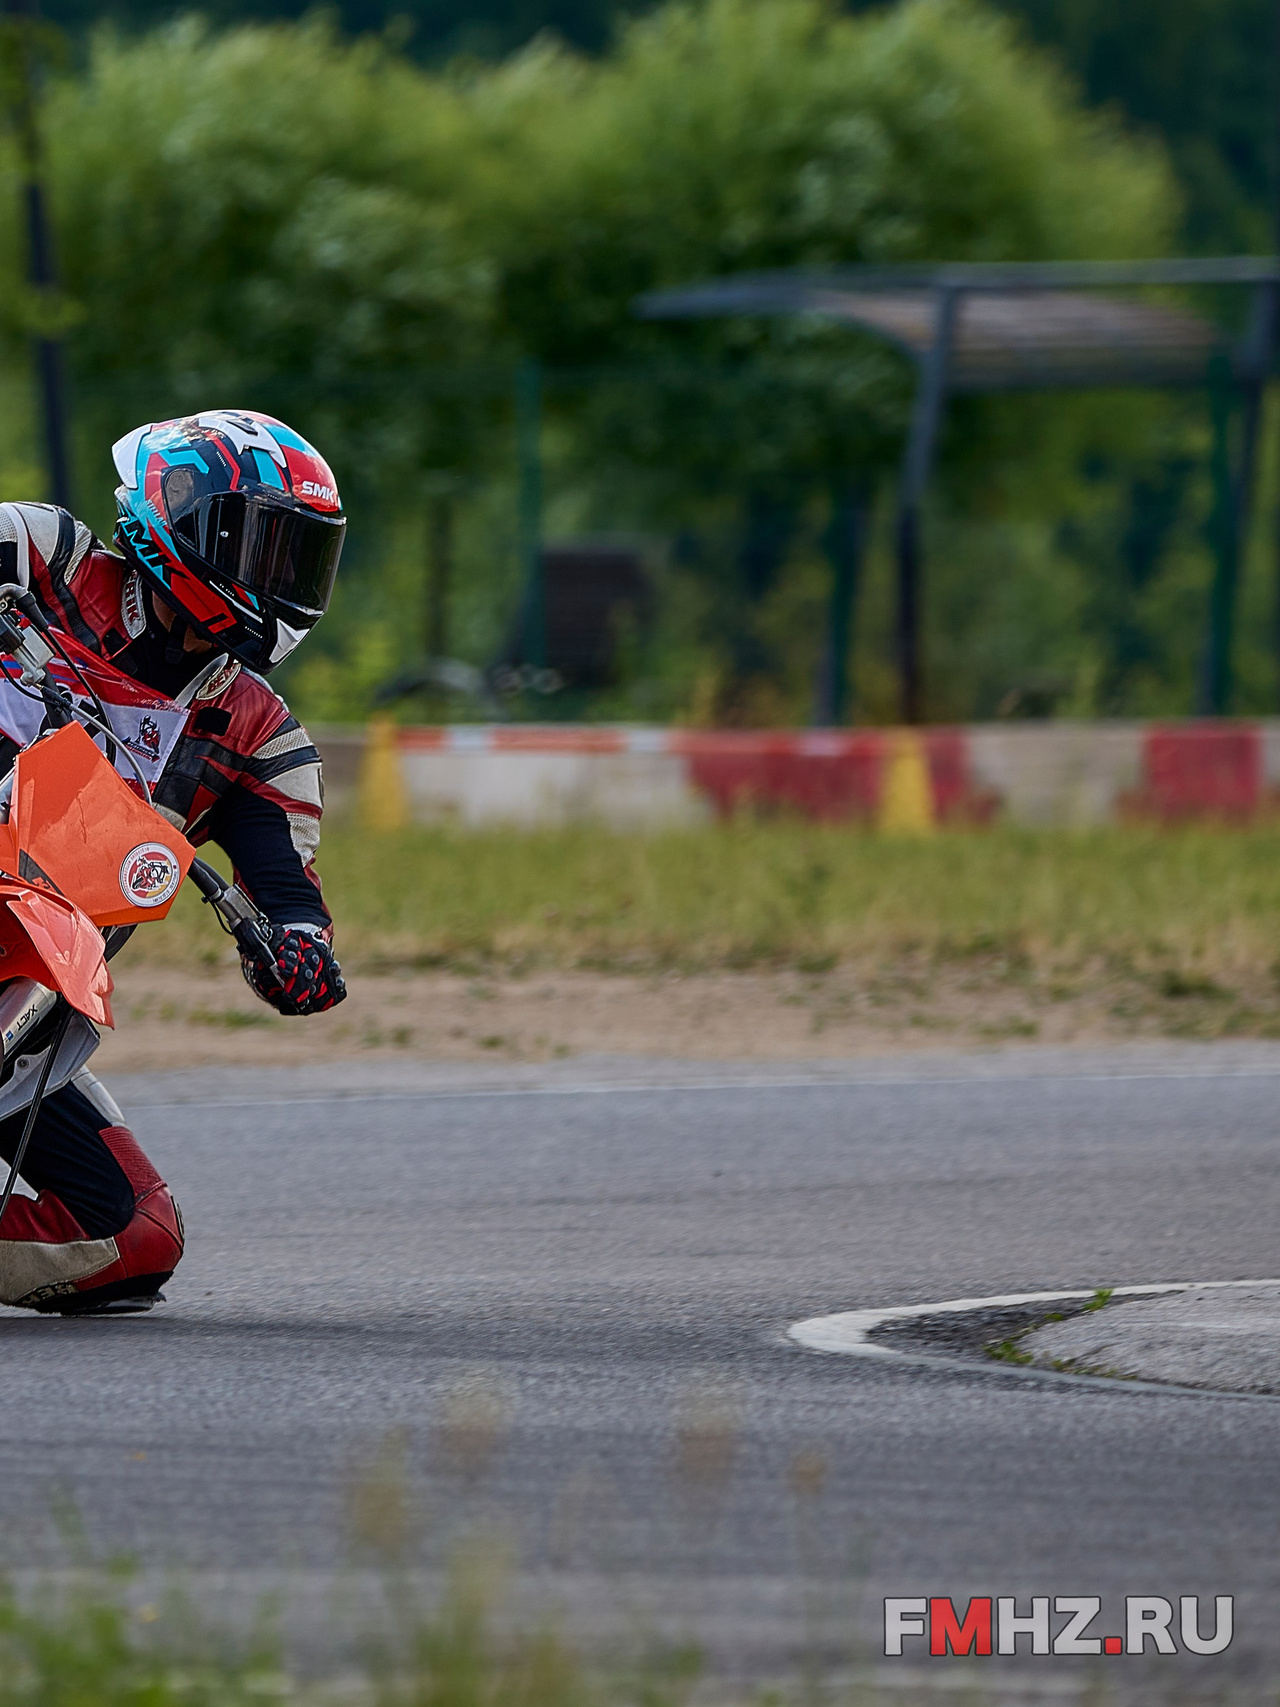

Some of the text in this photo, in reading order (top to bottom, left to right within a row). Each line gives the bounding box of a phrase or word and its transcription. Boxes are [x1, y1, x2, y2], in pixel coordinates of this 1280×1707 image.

[301, 480, 335, 503] SMK
[114, 502, 191, 590] MK
[17, 1004, 38, 1031] XACT
